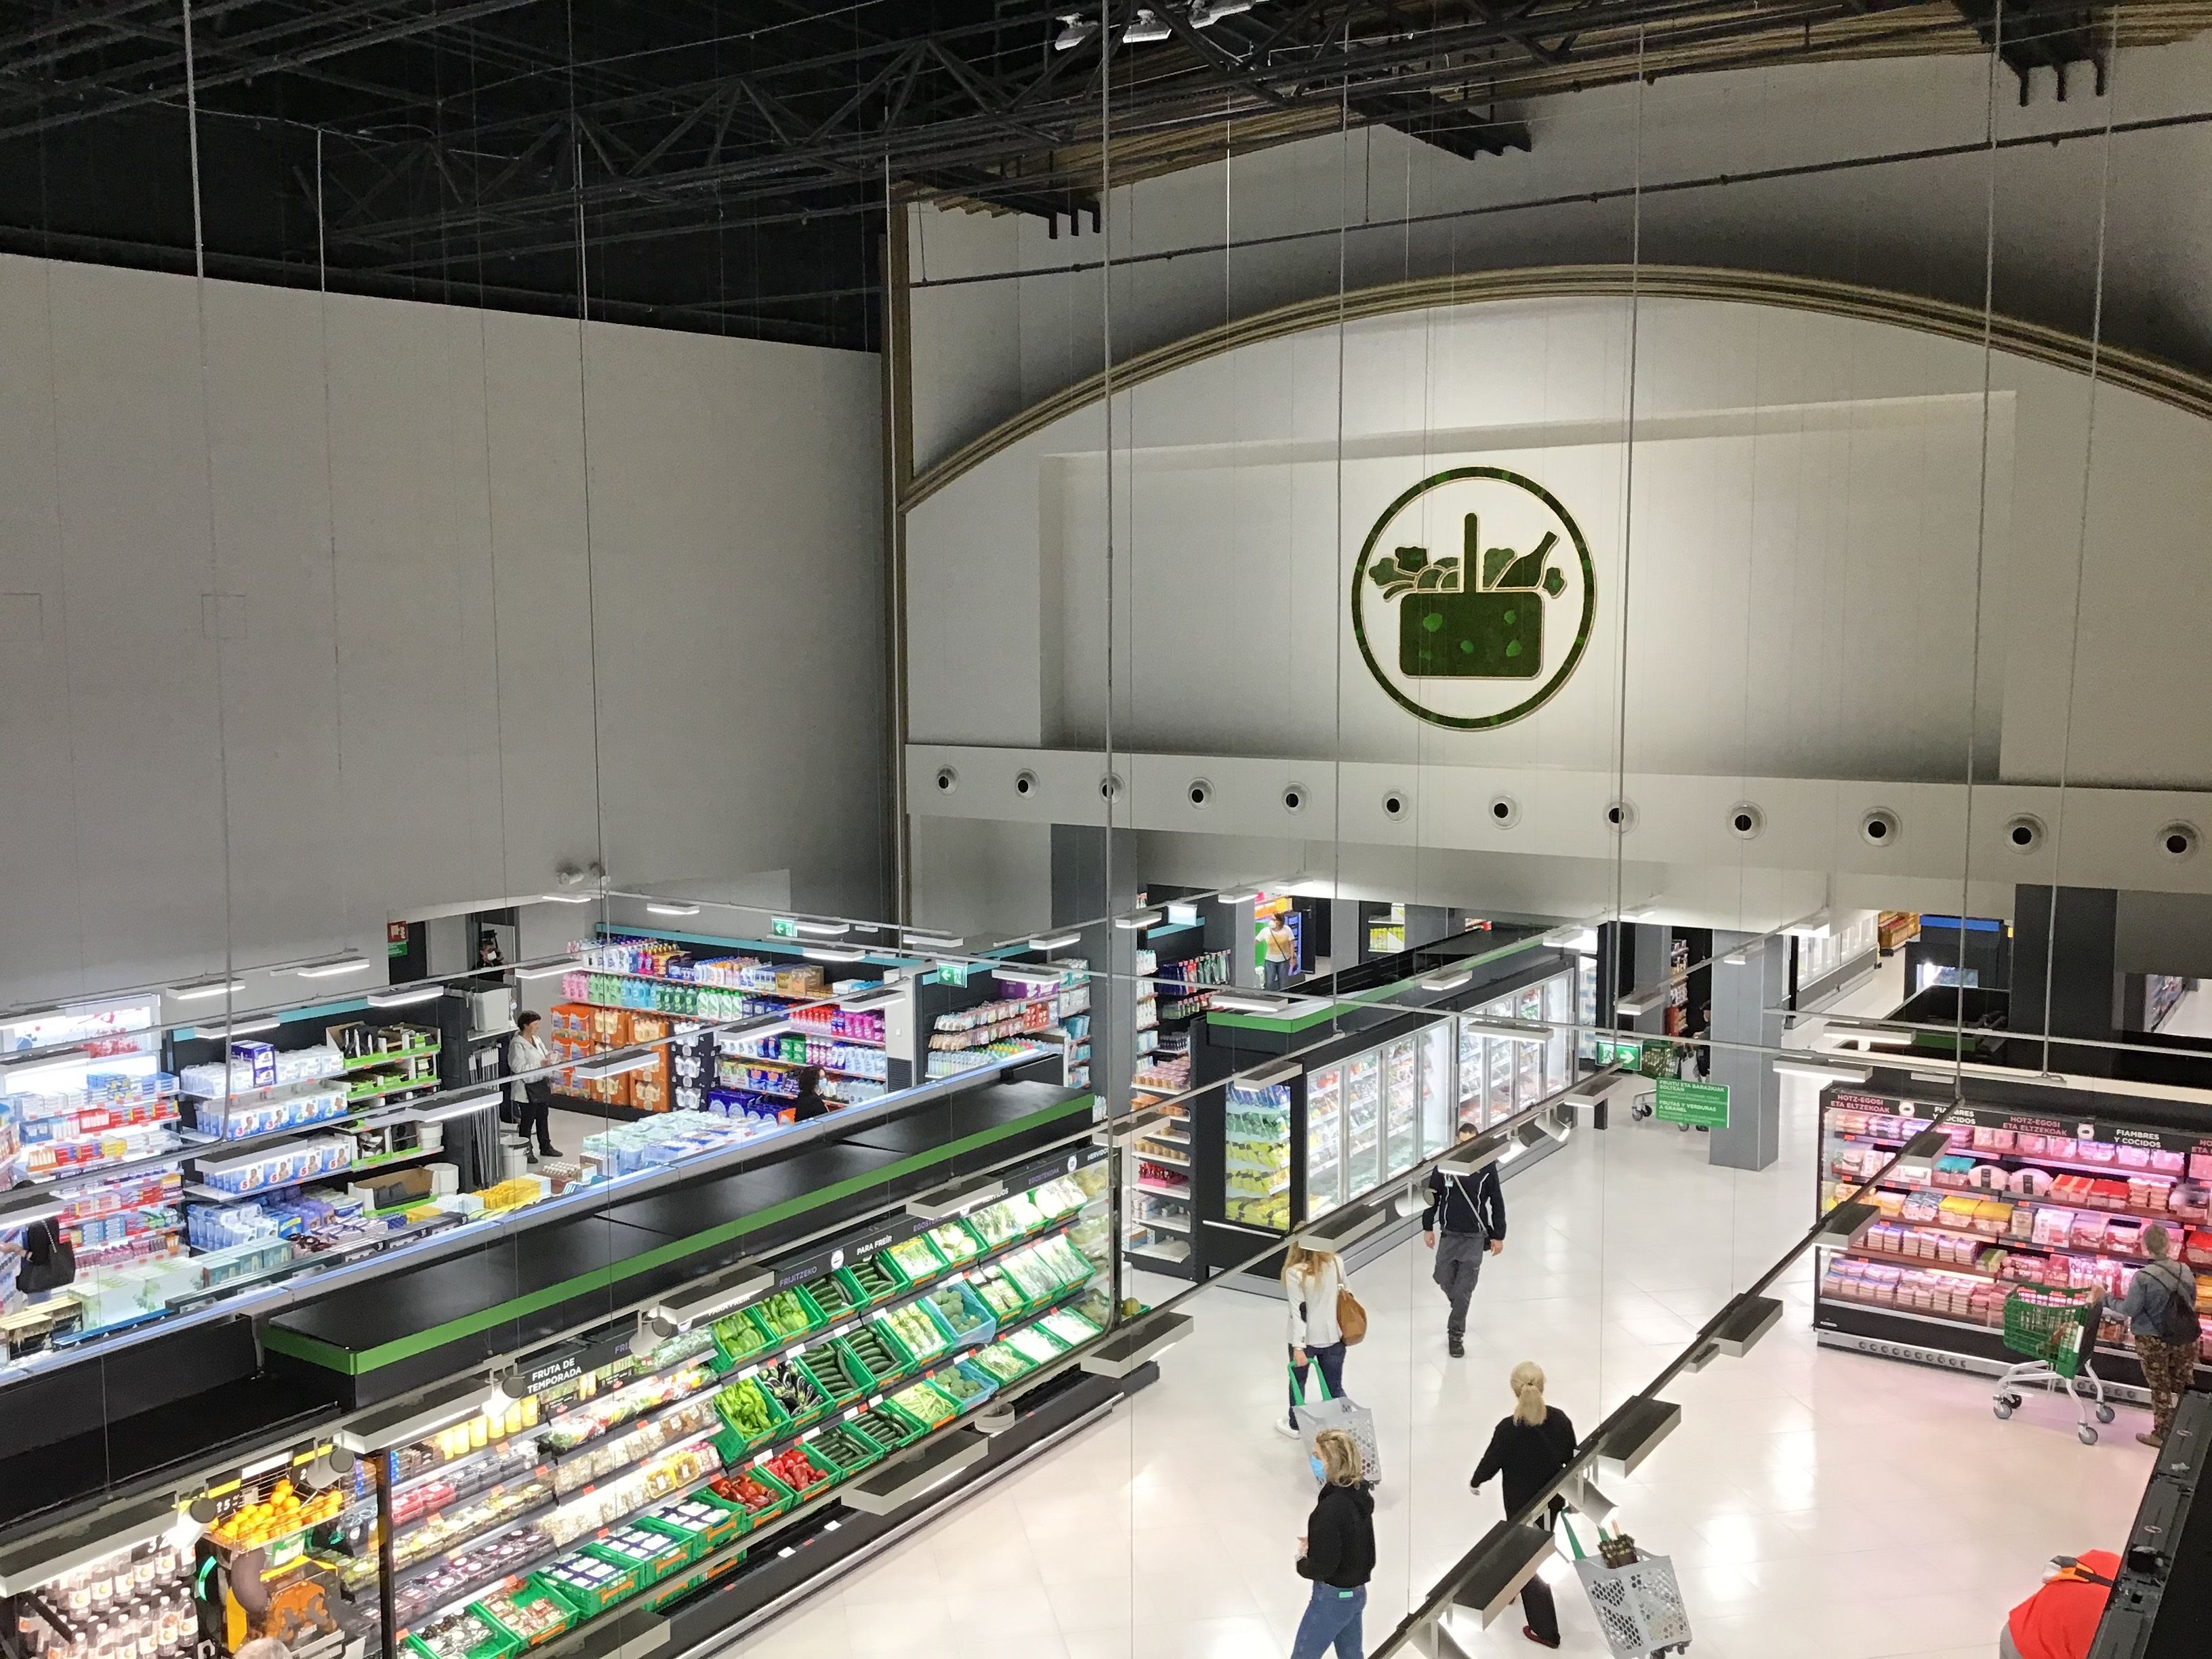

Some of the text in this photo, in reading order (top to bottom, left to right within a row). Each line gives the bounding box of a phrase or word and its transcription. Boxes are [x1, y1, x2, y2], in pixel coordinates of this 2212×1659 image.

[1837, 1094, 1884, 1106] HOTZ-EGOSI
[1686, 1103, 1717, 1111] VERDURAS
[1830, 1100, 1890, 1113] ETA ELTZEKOAK
[2010, 1116, 2060, 1128] HOTZ-EGOSI
[2003, 1122, 2068, 1136] ETA ELTZEKOAK
[2116, 1128, 2160, 1141] FIAMBRES
[2122, 1137, 2161, 1149] COCIDOS
[330, 1160, 336, 1168] 5
[300, 1166, 307, 1175] 5
[271, 1174, 277, 1182] 5
[241, 1181, 248, 1189] 5
[857, 1234, 893, 1255] PARA FREÍR
[779, 1266, 817, 1288] FRIJITZEKO
[532, 1357, 575, 1382] FRUTA DE
[527, 1366, 582, 1394] TEMPORADA
